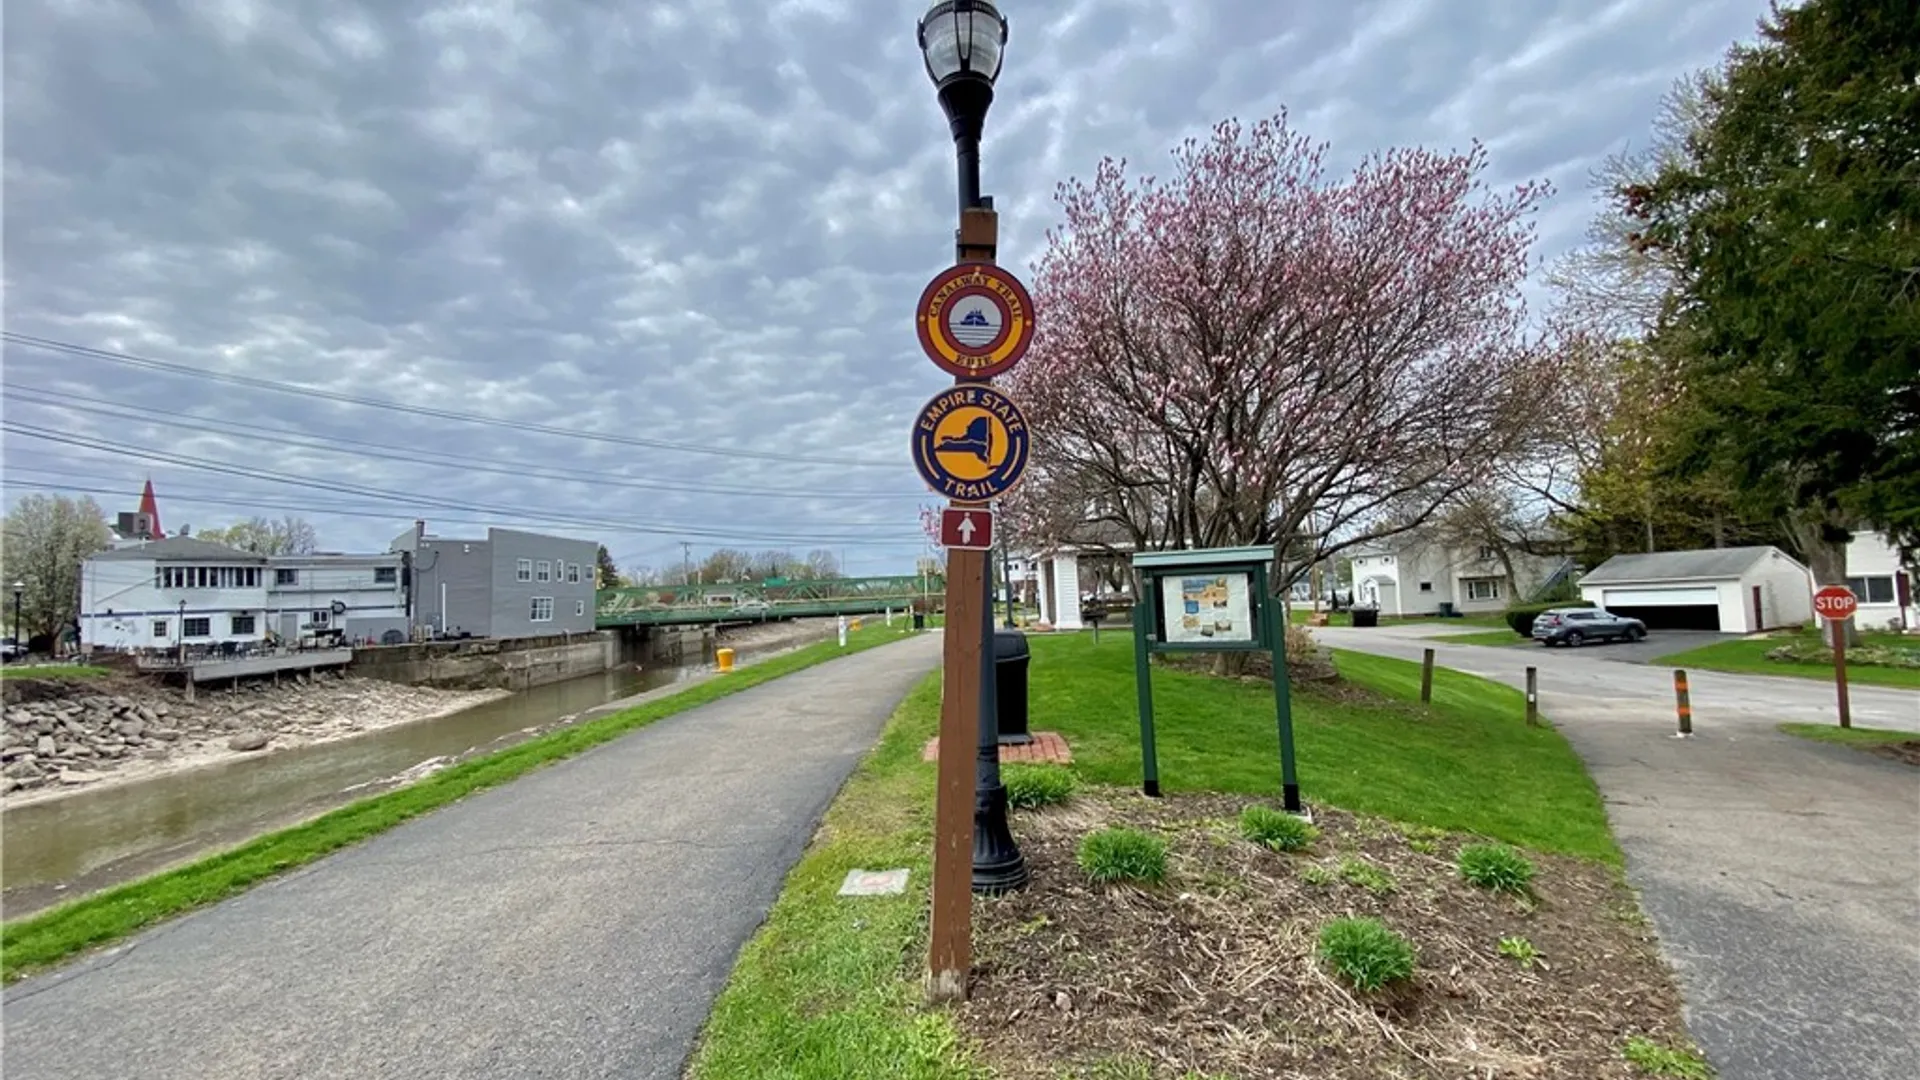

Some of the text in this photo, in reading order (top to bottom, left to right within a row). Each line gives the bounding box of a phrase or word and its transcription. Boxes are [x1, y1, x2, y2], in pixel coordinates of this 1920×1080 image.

[995, 282, 1022, 322] TRAIL
[921, 390, 1024, 434] EMPIRE STATE
[944, 478, 999, 498] TRAIL
[1816, 596, 1854, 610] STOP
